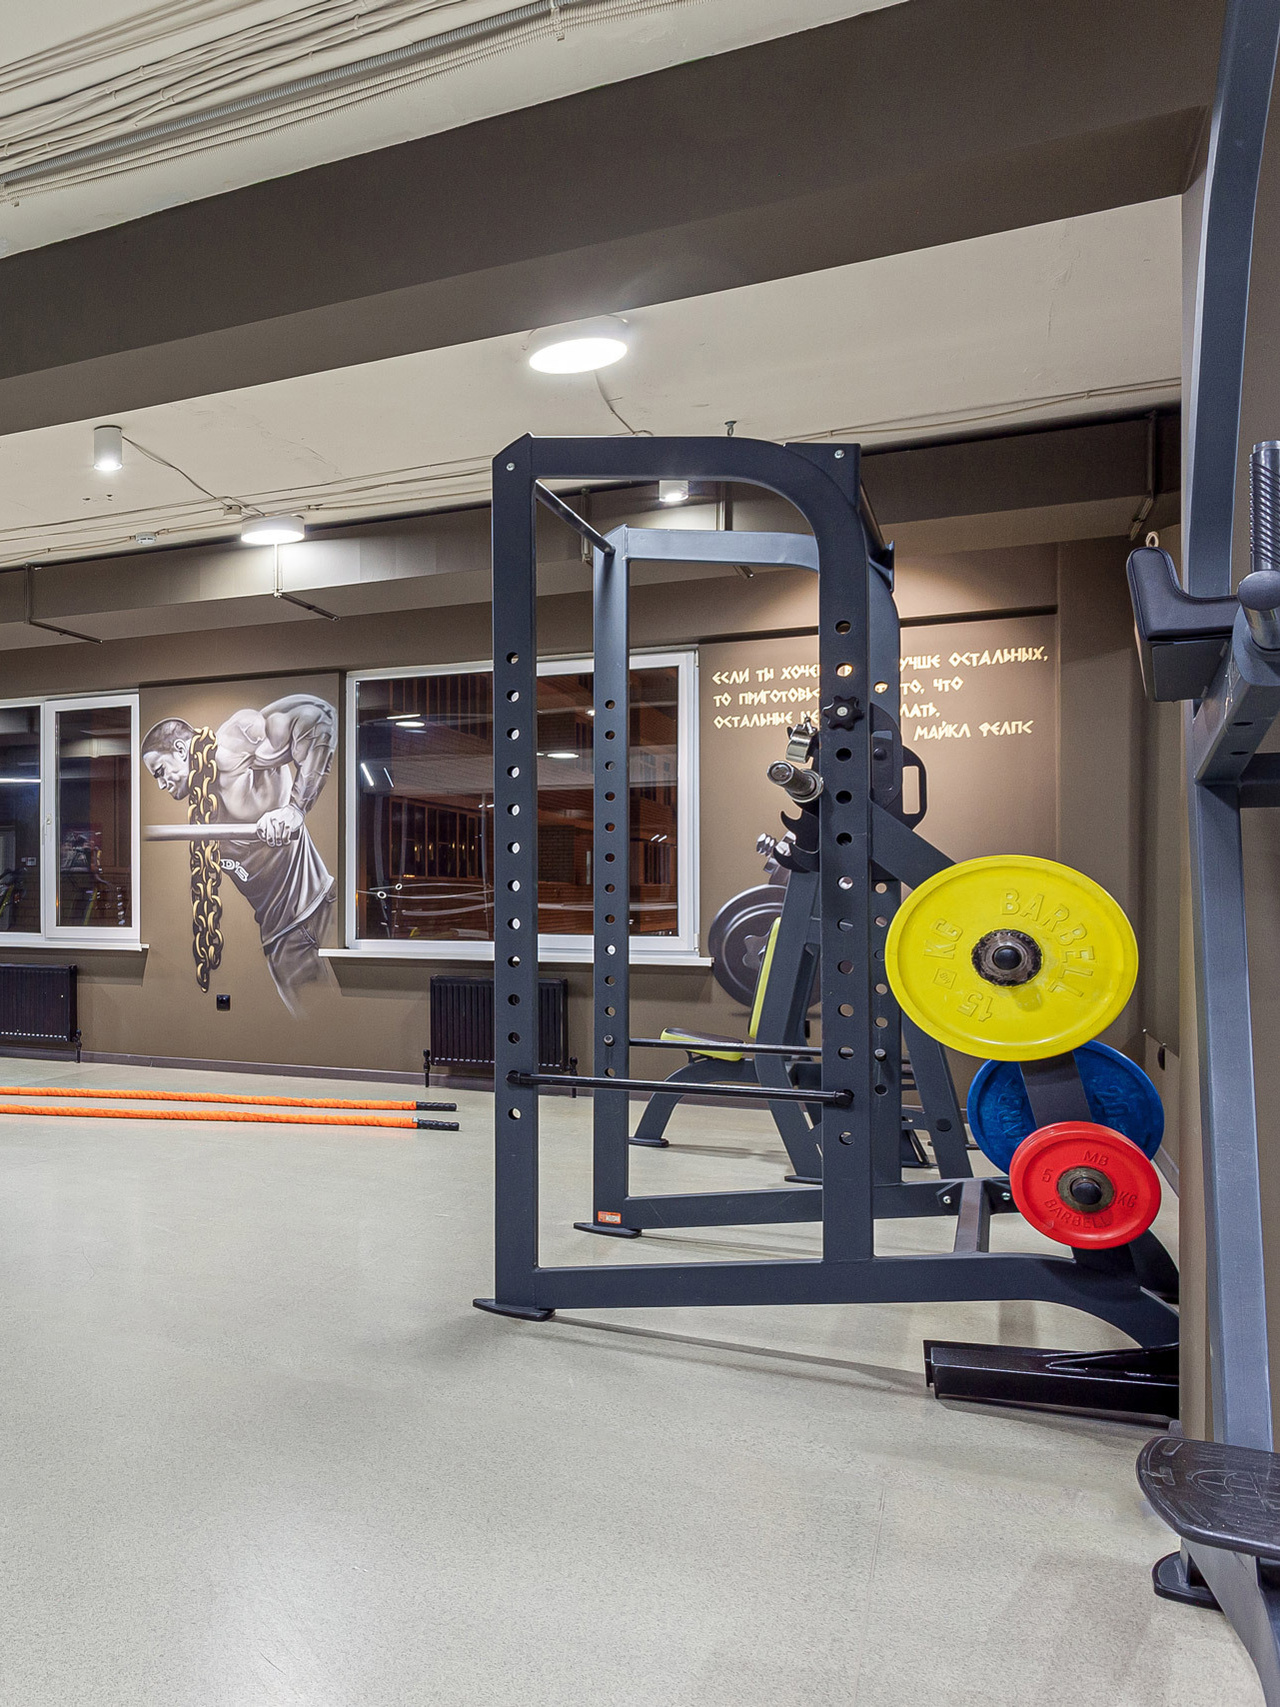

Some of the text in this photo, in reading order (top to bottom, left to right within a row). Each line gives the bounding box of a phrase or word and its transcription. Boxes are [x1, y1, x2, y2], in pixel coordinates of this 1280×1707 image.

[712, 668, 749, 685] ЕСЛИ
[756, 667, 774, 682] ТЫ
[900, 654, 941, 671] УЧШЕ
[948, 646, 1048, 668] ОСТАЛЬНЫХ,
[713, 692, 732, 707] ТО
[738, 687, 820, 706] ПРИГОТОВЬС
[933, 676, 964, 692] ЧТО
[713, 711, 793, 729] ОСТАЛЬНЫЕ
[900, 702, 941, 718] ЛАТЬ,
[913, 720, 1034, 741] МАЙКЛ ФЕЛПС
[1001, 888, 1095, 998] BARBELL
[923, 918, 994, 1022] 15 KG
[1083, 1150, 1109, 1166] MB
[1042, 1168, 1138, 1208] 5 KG
[1043, 1198, 1113, 1229] BARBELL
